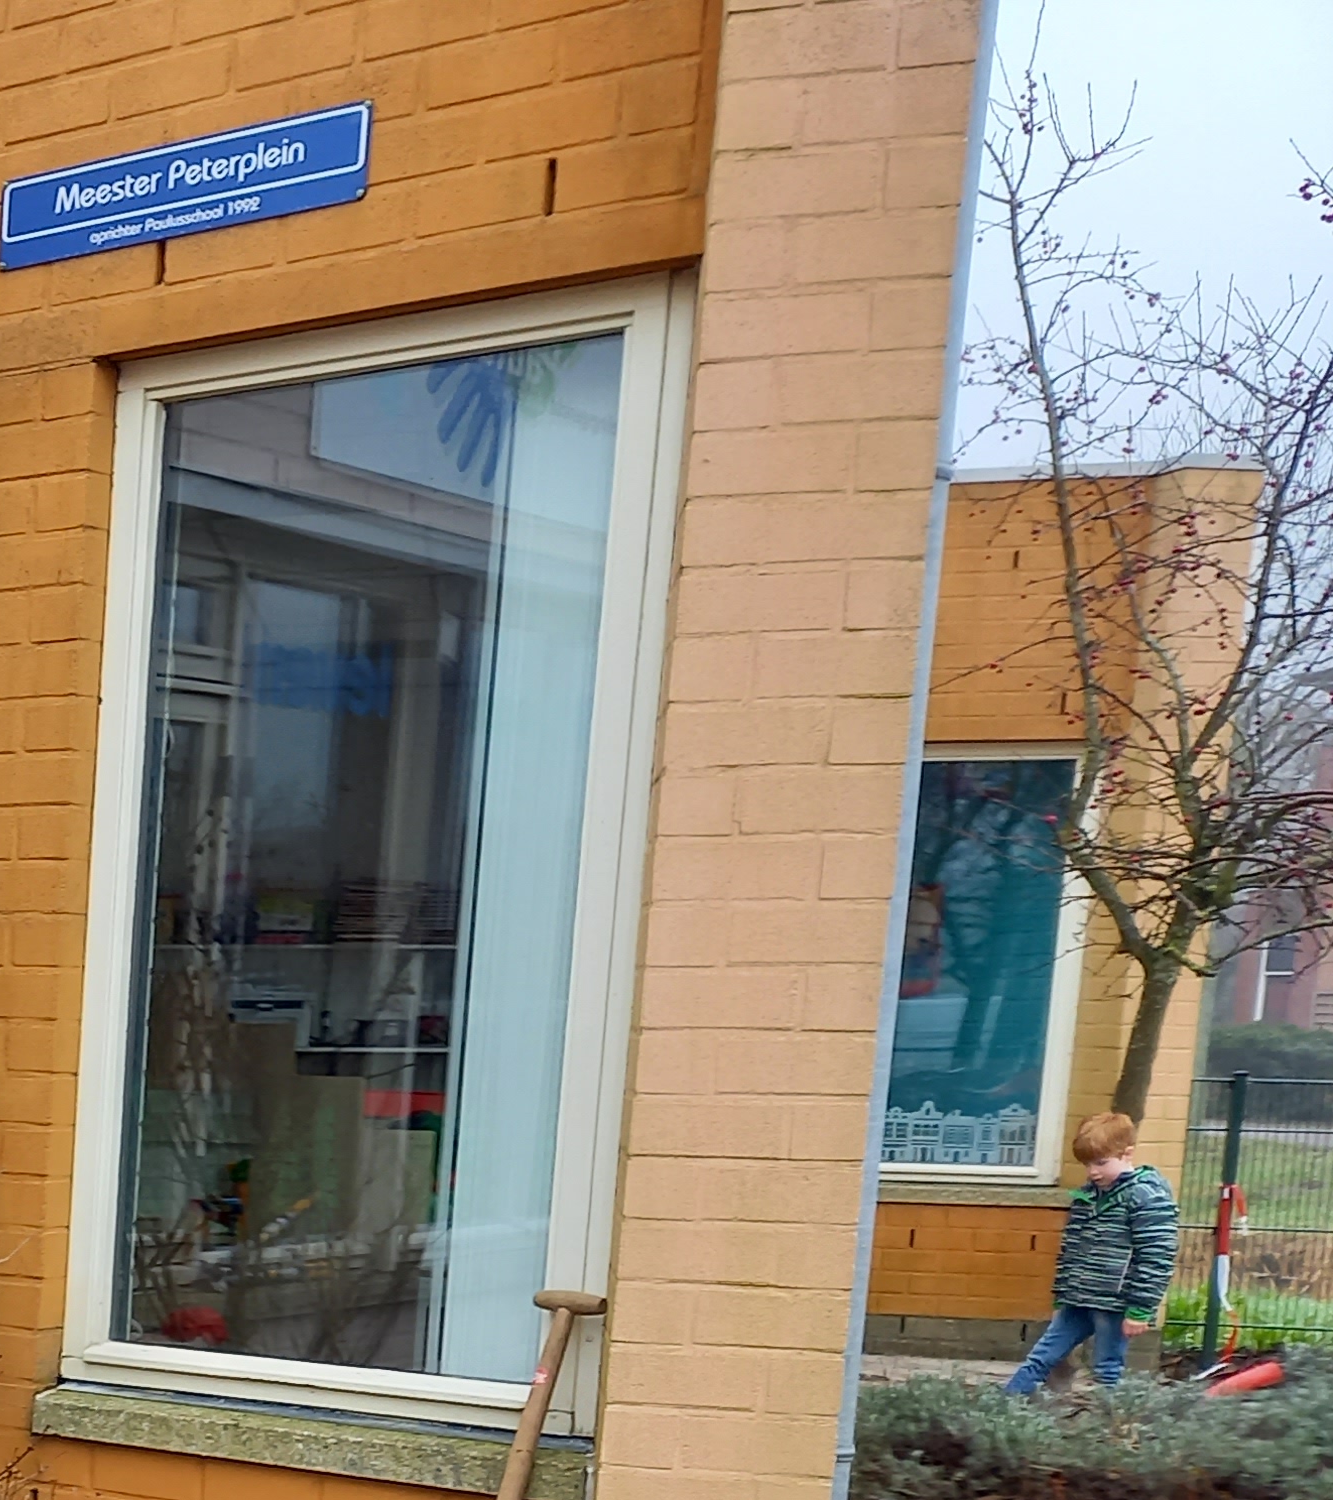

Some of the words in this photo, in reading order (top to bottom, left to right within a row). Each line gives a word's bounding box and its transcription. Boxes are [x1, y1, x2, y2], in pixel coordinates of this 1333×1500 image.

[53, 172, 162, 214] Meester
[167, 137, 306, 189] Peterplein
[89, 222, 143, 246] oprichter
[144, 203, 224, 233] Paulusschool
